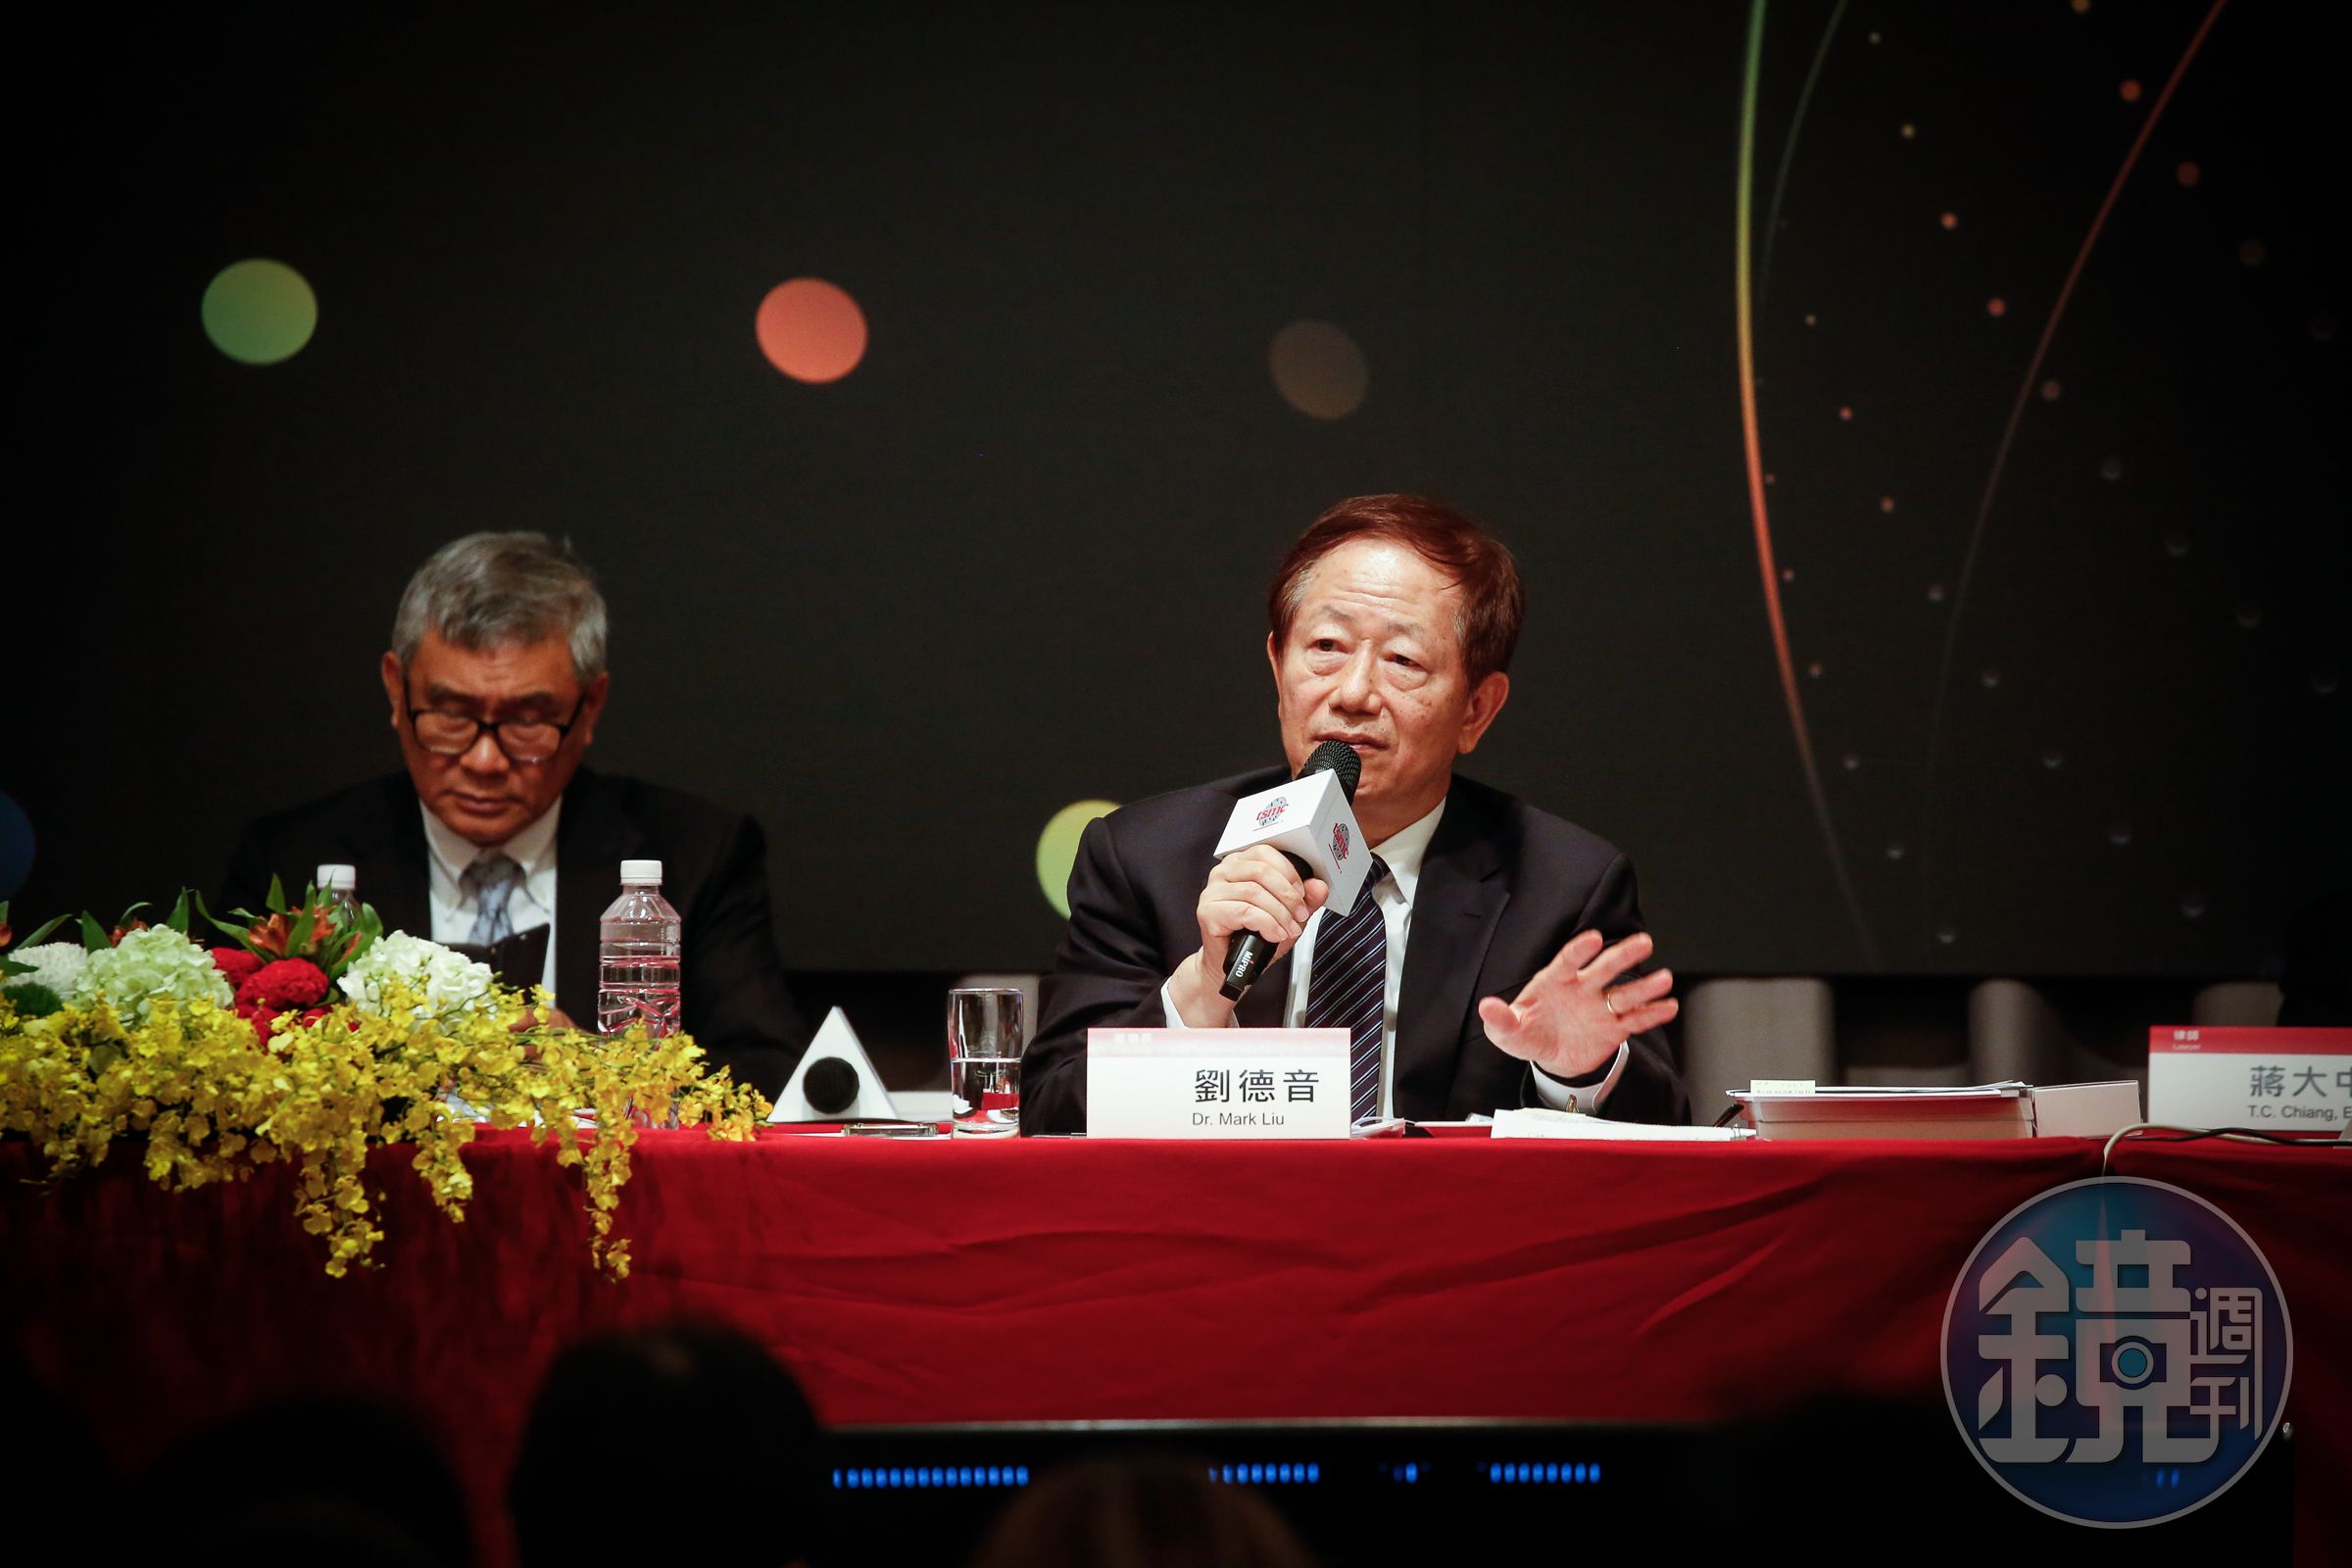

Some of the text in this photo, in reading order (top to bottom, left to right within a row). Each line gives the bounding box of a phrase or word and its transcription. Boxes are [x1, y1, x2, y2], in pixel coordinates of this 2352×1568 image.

[1194, 1069, 1319, 1103] 劉德音
[1192, 1112, 1285, 1126] Dr. Mark Liu
[2248, 1104, 2277, 1118] T.C.
[2280, 1103, 2338, 1122] Chiang,
